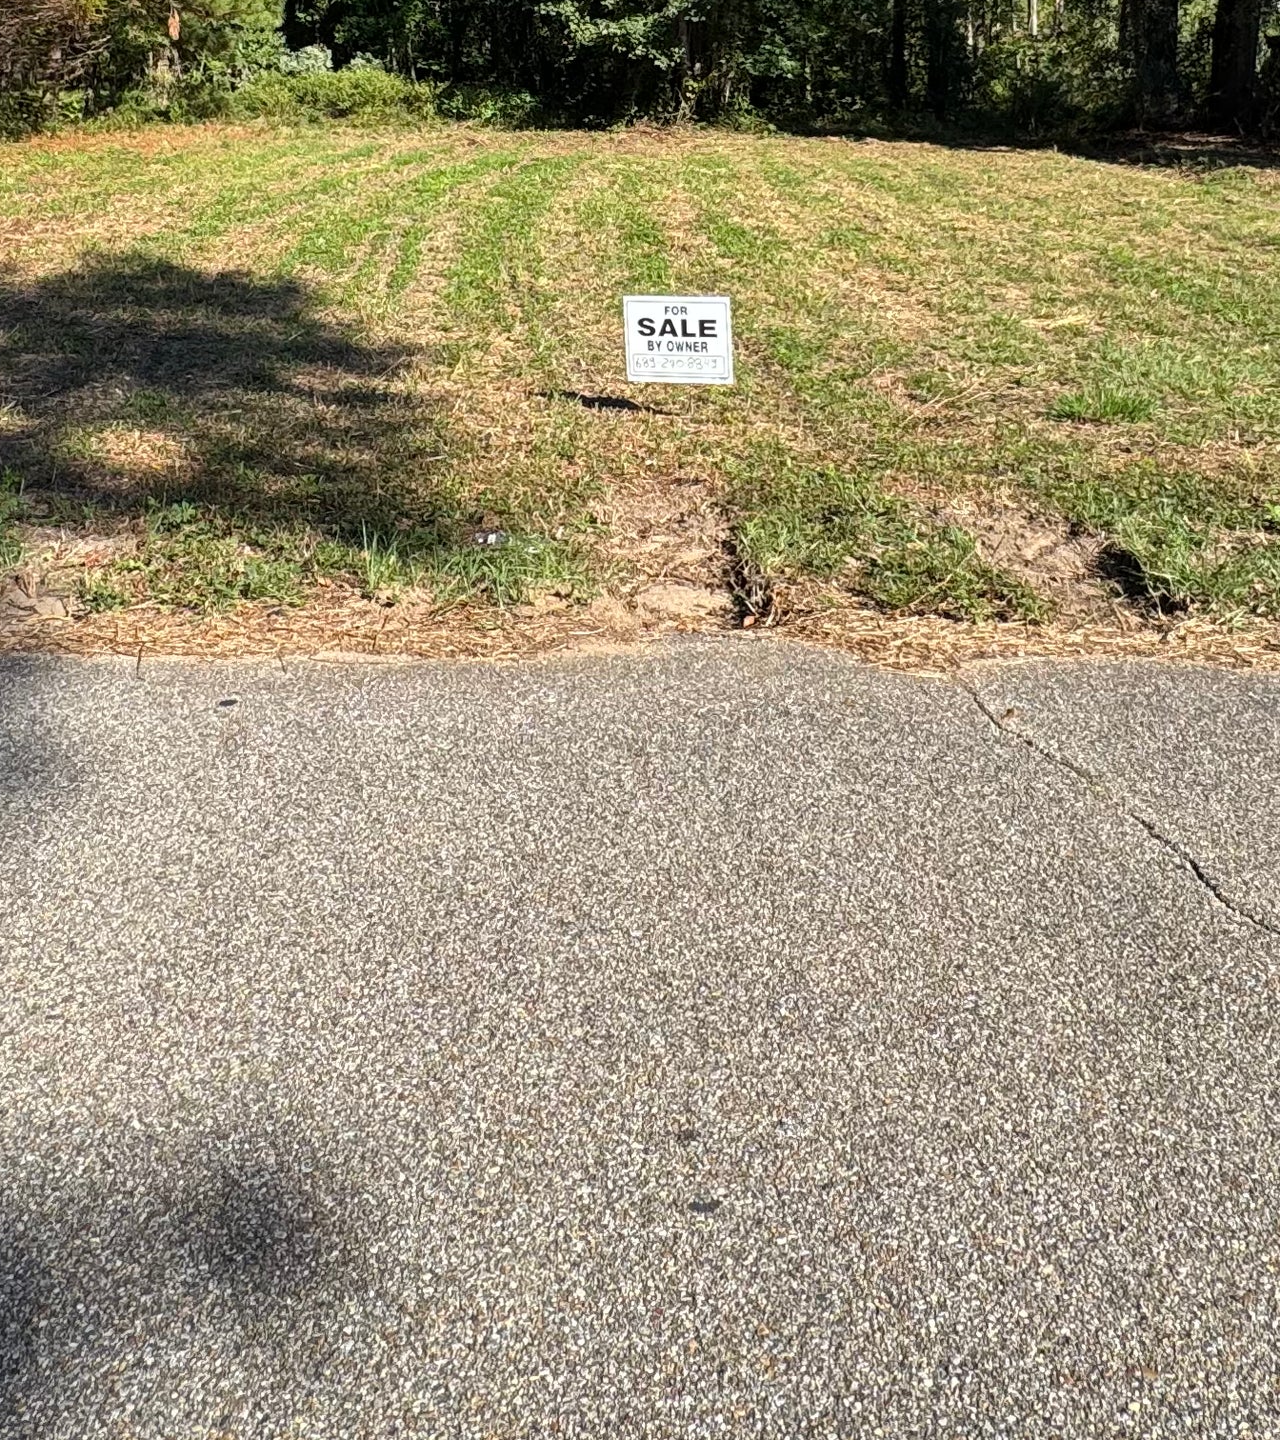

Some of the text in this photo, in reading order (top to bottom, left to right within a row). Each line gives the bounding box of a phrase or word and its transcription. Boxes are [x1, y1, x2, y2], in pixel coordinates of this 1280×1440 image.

[664, 306, 688, 315] FOR
[637, 317, 718, 338] SALE
[647, 340, 708, 353] BY OWNER
